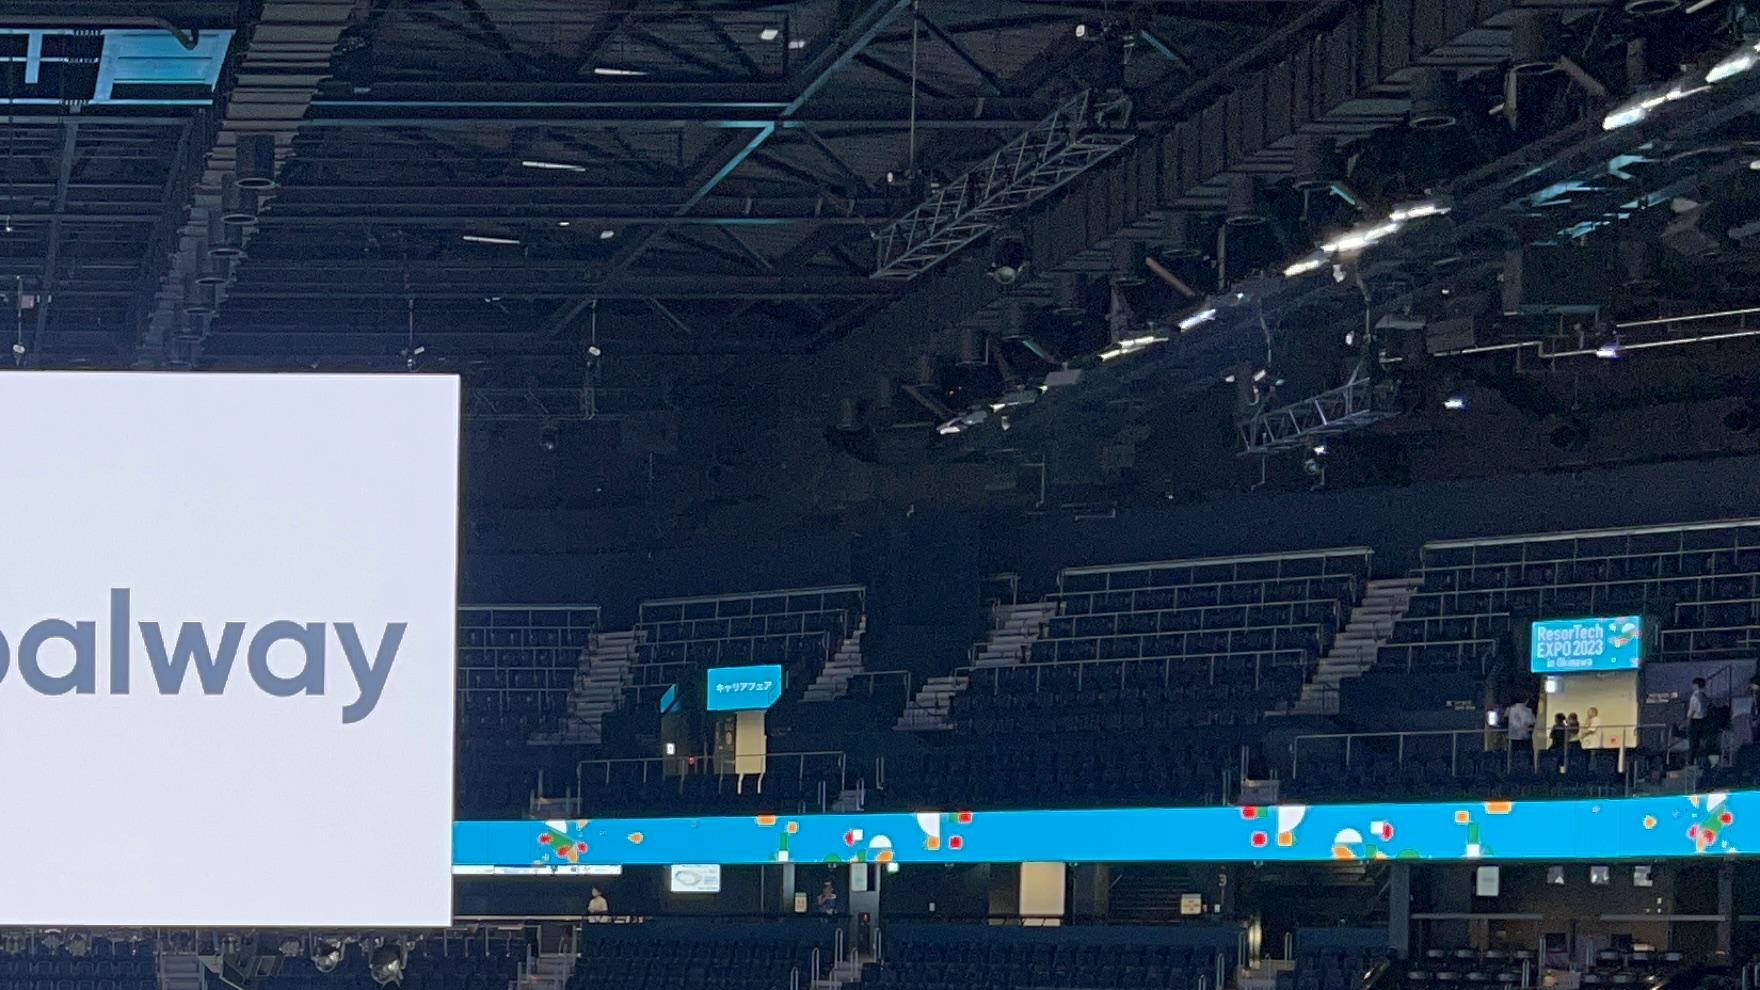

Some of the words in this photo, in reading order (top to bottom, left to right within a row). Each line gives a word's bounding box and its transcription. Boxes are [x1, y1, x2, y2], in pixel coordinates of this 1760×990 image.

[1537, 624, 1604, 642] ResorTech
[1537, 640, 1571, 658] EXPO
[1572, 639, 1604, 656] 2023
[714, 678, 773, 694] キャリアフェア
